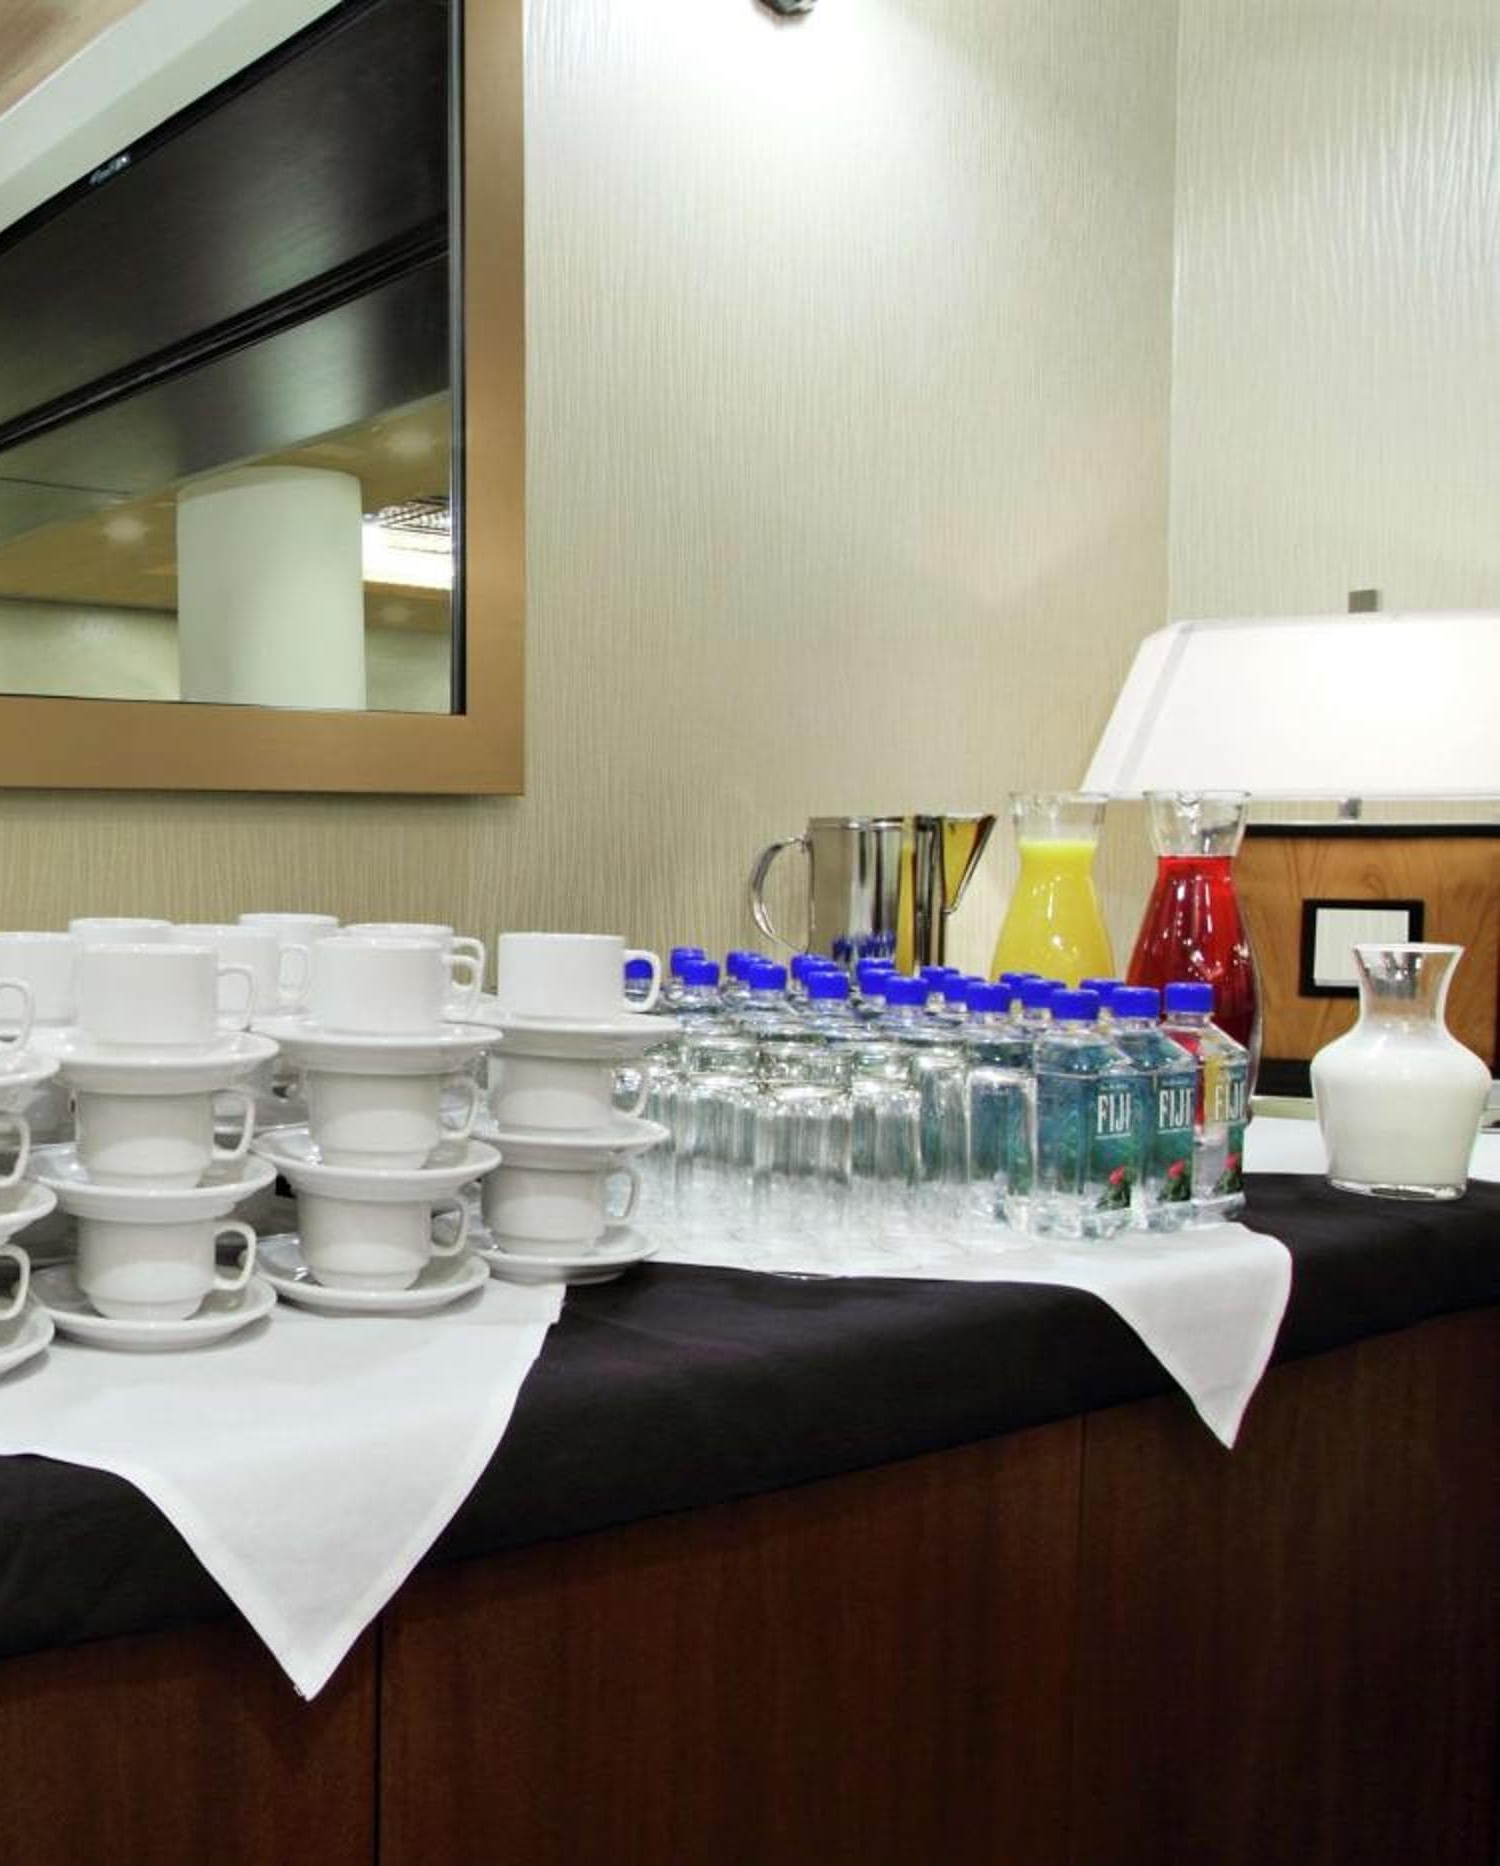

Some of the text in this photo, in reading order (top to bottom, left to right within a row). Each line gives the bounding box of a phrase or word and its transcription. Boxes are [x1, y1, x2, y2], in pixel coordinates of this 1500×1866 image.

[1097, 1092, 1131, 1134] FIJI
[1158, 1088, 1194, 1129] FIJI
[1214, 1080, 1246, 1121] FIJI
